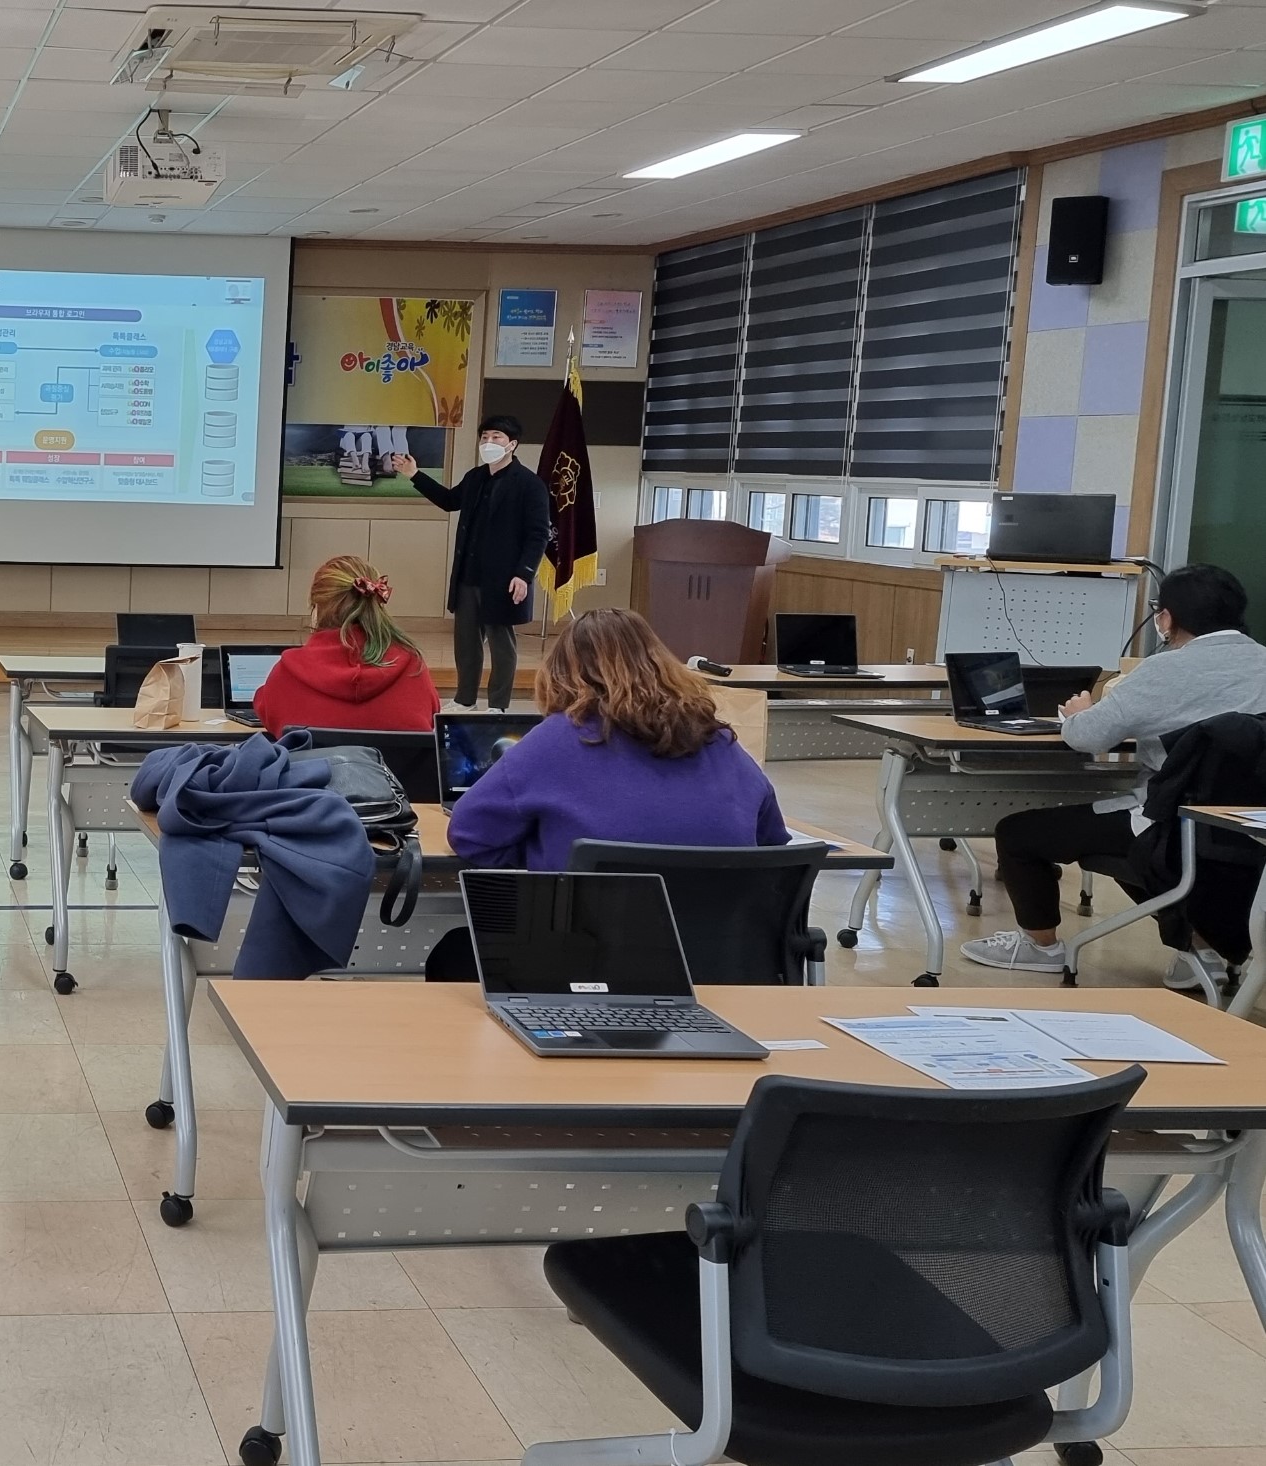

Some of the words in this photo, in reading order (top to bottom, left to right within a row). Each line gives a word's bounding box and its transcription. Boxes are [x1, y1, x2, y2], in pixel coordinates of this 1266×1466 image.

[66, 310, 85, 320] 로그인
[386, 342, 415, 351] 경남교육
[340, 350, 430, 384] 아이좋아
[47, 454, 60, 463] 성장
[133, 456, 146, 465] 참여
